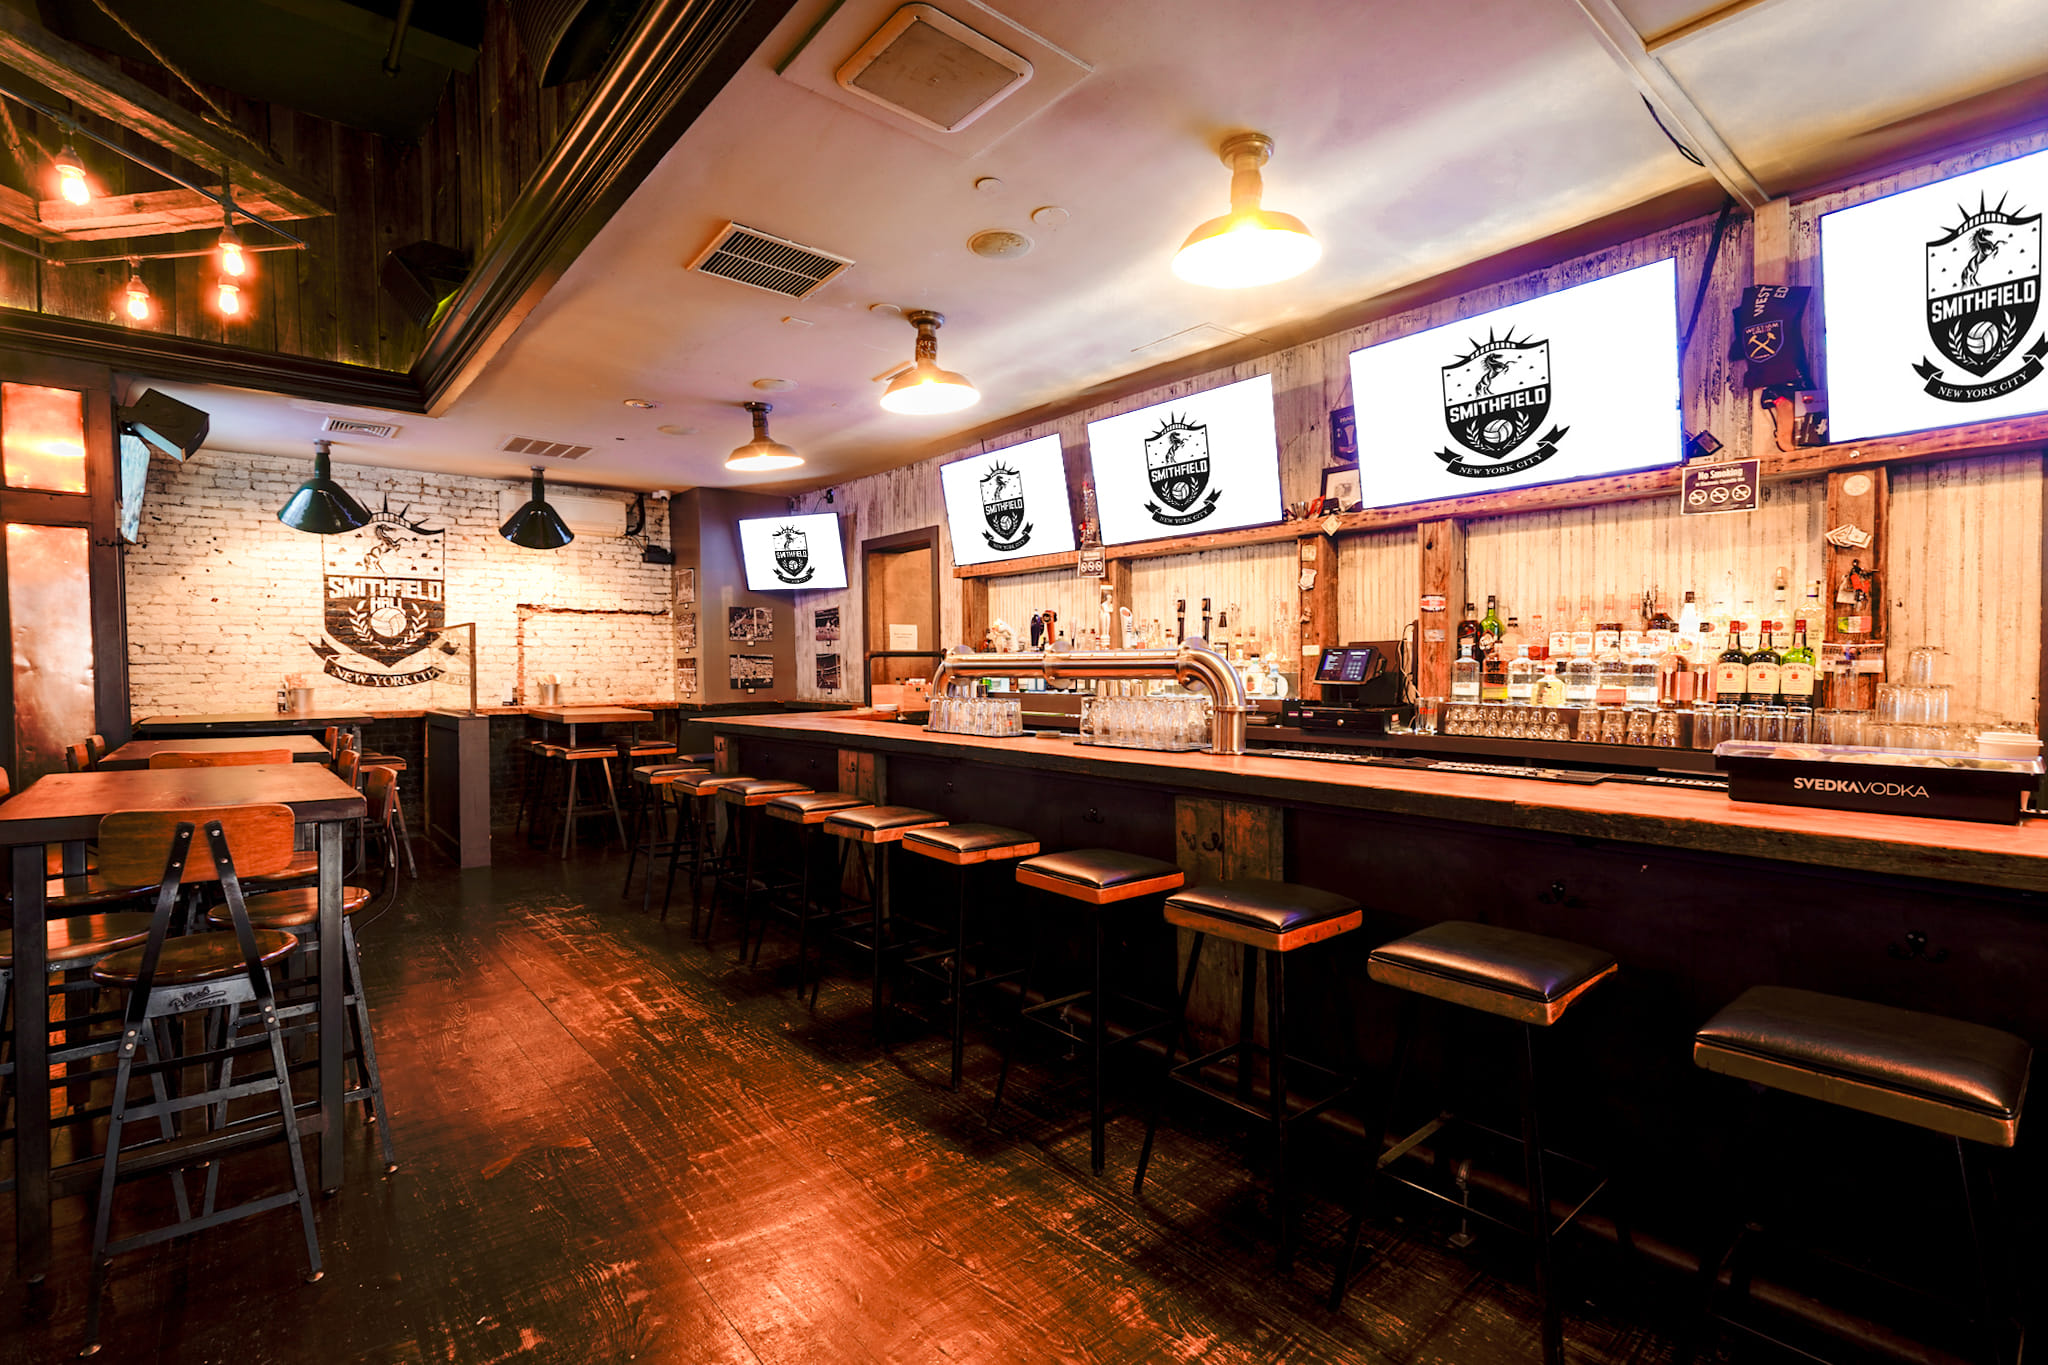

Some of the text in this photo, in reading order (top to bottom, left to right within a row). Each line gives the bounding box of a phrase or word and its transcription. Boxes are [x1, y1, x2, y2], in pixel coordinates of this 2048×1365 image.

[1753, 286, 1774, 317] WEST
[1931, 279, 2037, 324] SMITHFIELD
[1937, 370, 2028, 399] NEW YORK CITY
[1449, 387, 1547, 423] SMITHFIELD
[1150, 459, 1208, 483] SMITHFIELD
[1458, 453, 1543, 476] NEW YORK CITY
[1697, 467, 1744, 481] No Smoking
[984, 498, 1024, 516] SMITHFIELD
[327, 576, 442, 602] SMITHFIELD
[332, 667, 368, 684] NEW
[372, 675, 412, 687] YORK
